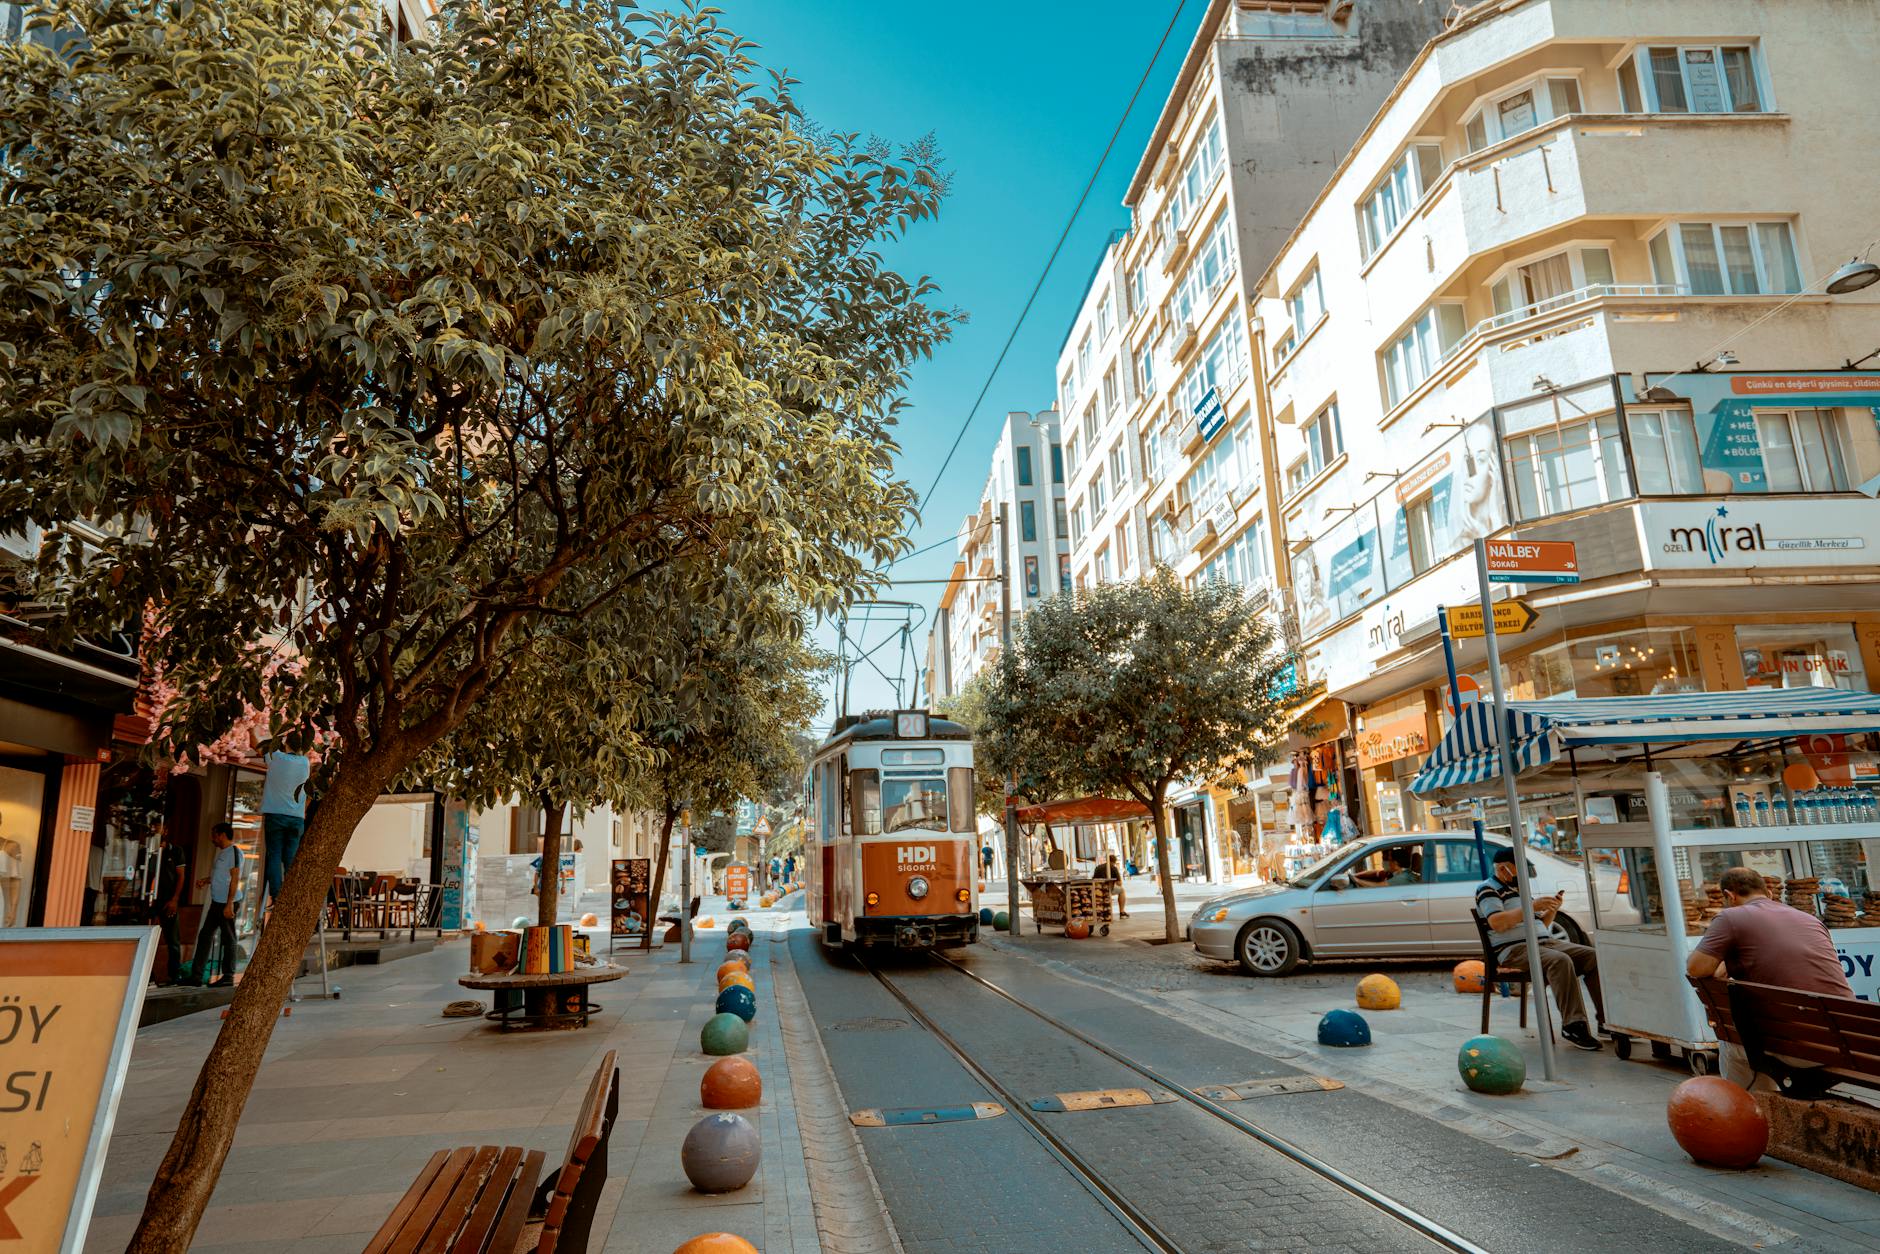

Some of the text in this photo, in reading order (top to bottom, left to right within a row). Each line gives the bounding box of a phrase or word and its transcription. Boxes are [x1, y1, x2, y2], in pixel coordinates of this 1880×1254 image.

[1746, 380, 1773, 389] Çünkü
[1787, 380, 1817, 390] değerli
[1814, 539, 1849, 549] Merkezi
[1489, 544, 1541, 558] NAİLBEY
[1491, 560, 1519, 568] SOKAĞI
[1494, 618, 1520, 630] ERKEZİ
[1757, 657, 1849, 673] ALTIN OPTİK
[900, 716, 924, 736] 20
[897, 846, 936, 863] HDI
[898, 863, 936, 872] SİGORTA
